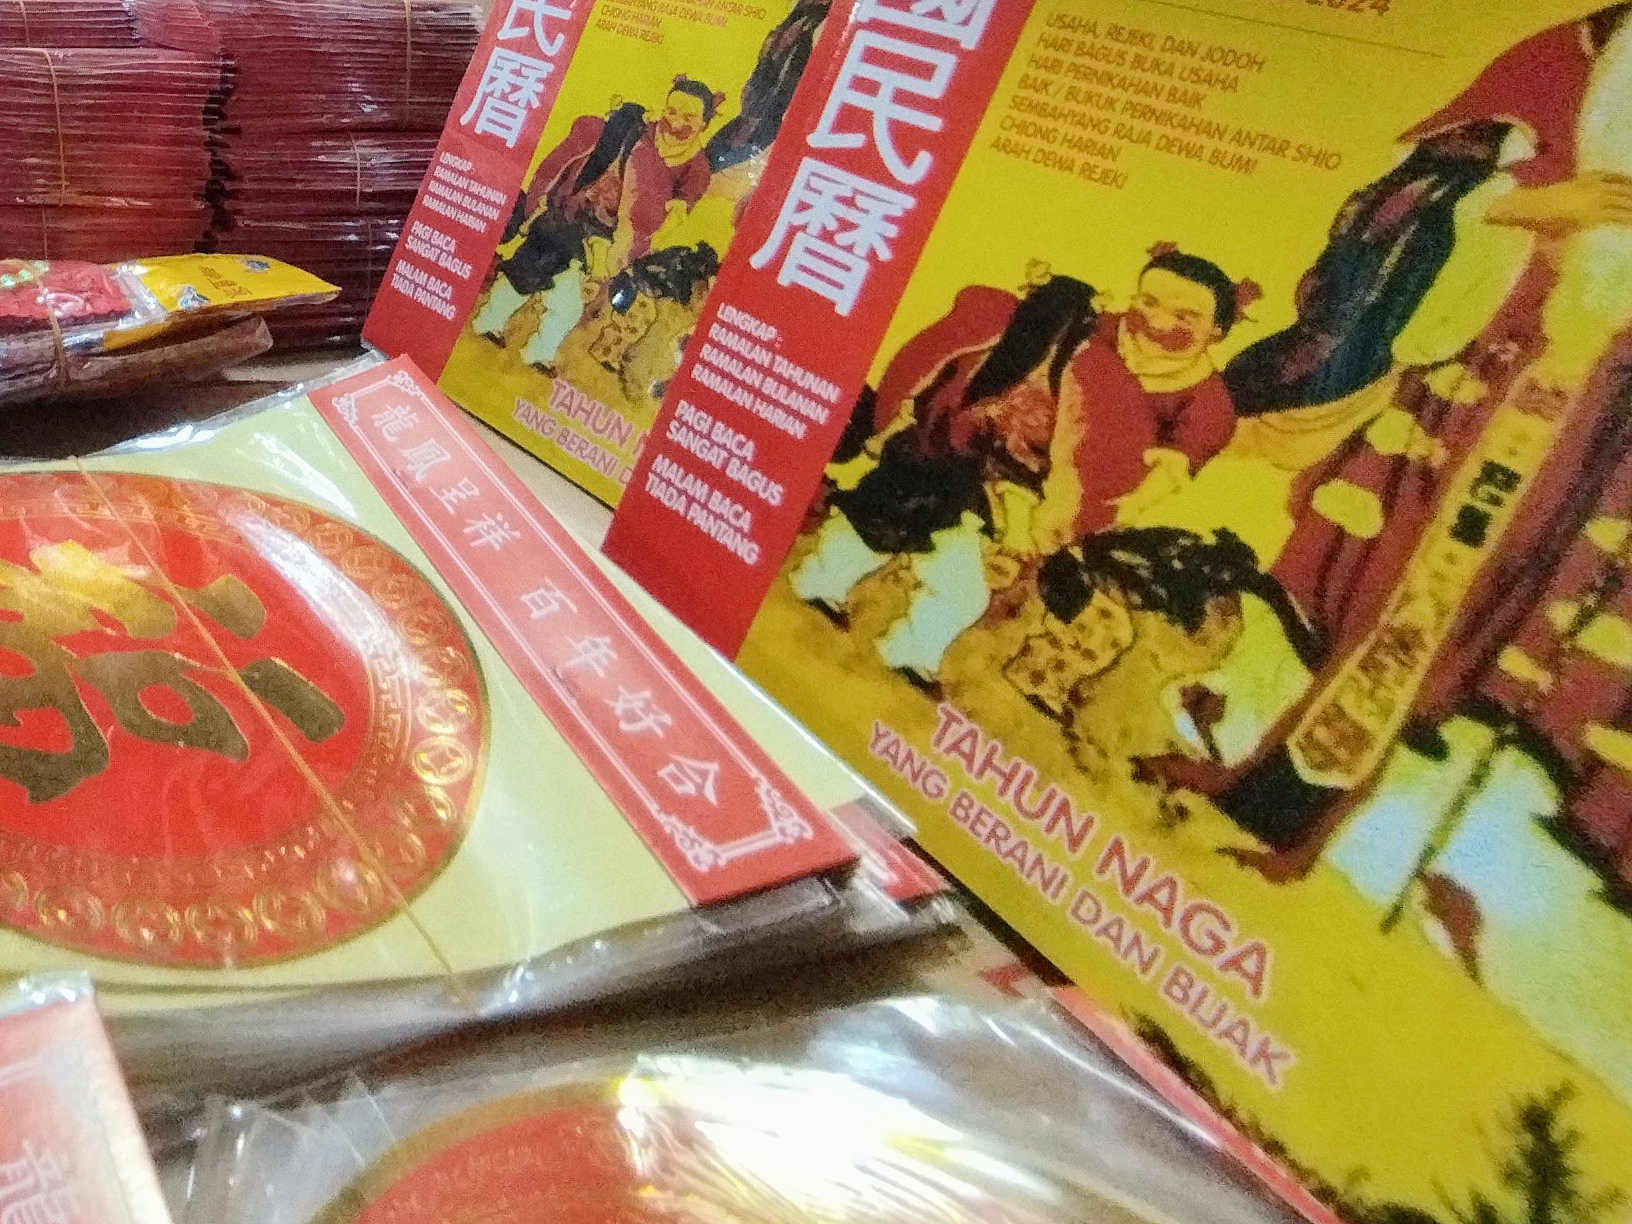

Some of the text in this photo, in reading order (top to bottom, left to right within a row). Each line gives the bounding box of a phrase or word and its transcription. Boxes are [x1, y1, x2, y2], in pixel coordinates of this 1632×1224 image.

[1074, 41, 1127, 68] BAGUS
[1200, 46, 1265, 73] JODOH
[1229, 126, 1291, 159] ANTAR
[1291, 142, 1343, 171] SHIO
[430, 231, 456, 253] BACA
[438, 251, 473, 280] BAGUS
[426, 275, 453, 301] BACA
[690, 364, 755, 410] RAMALAN
[700, 343, 830, 425] RAMALAN BULANAN
[708, 322, 842, 404] RAMALAN TAHUNAN
[513, 396, 558, 438] YANG
[555, 427, 619, 479] BERANI
[549, 377, 634, 448] TAHUN
[675, 399, 756, 462] PAGI BACA
[651, 454, 710, 504] MALAM
[708, 490, 753, 533] BACA
[667, 420, 729, 469] SANGAT
[725, 456, 785, 507] BAGUS
[645, 472, 688, 517] TIADA
[686, 503, 760, 566] PANTANG
[520, 576, 720, 807] 百年好合
[932, 702, 1270, 1000] TAHUN NAGA
[869, 720, 1296, 1092] YANG BERANI DAN BIJAK
